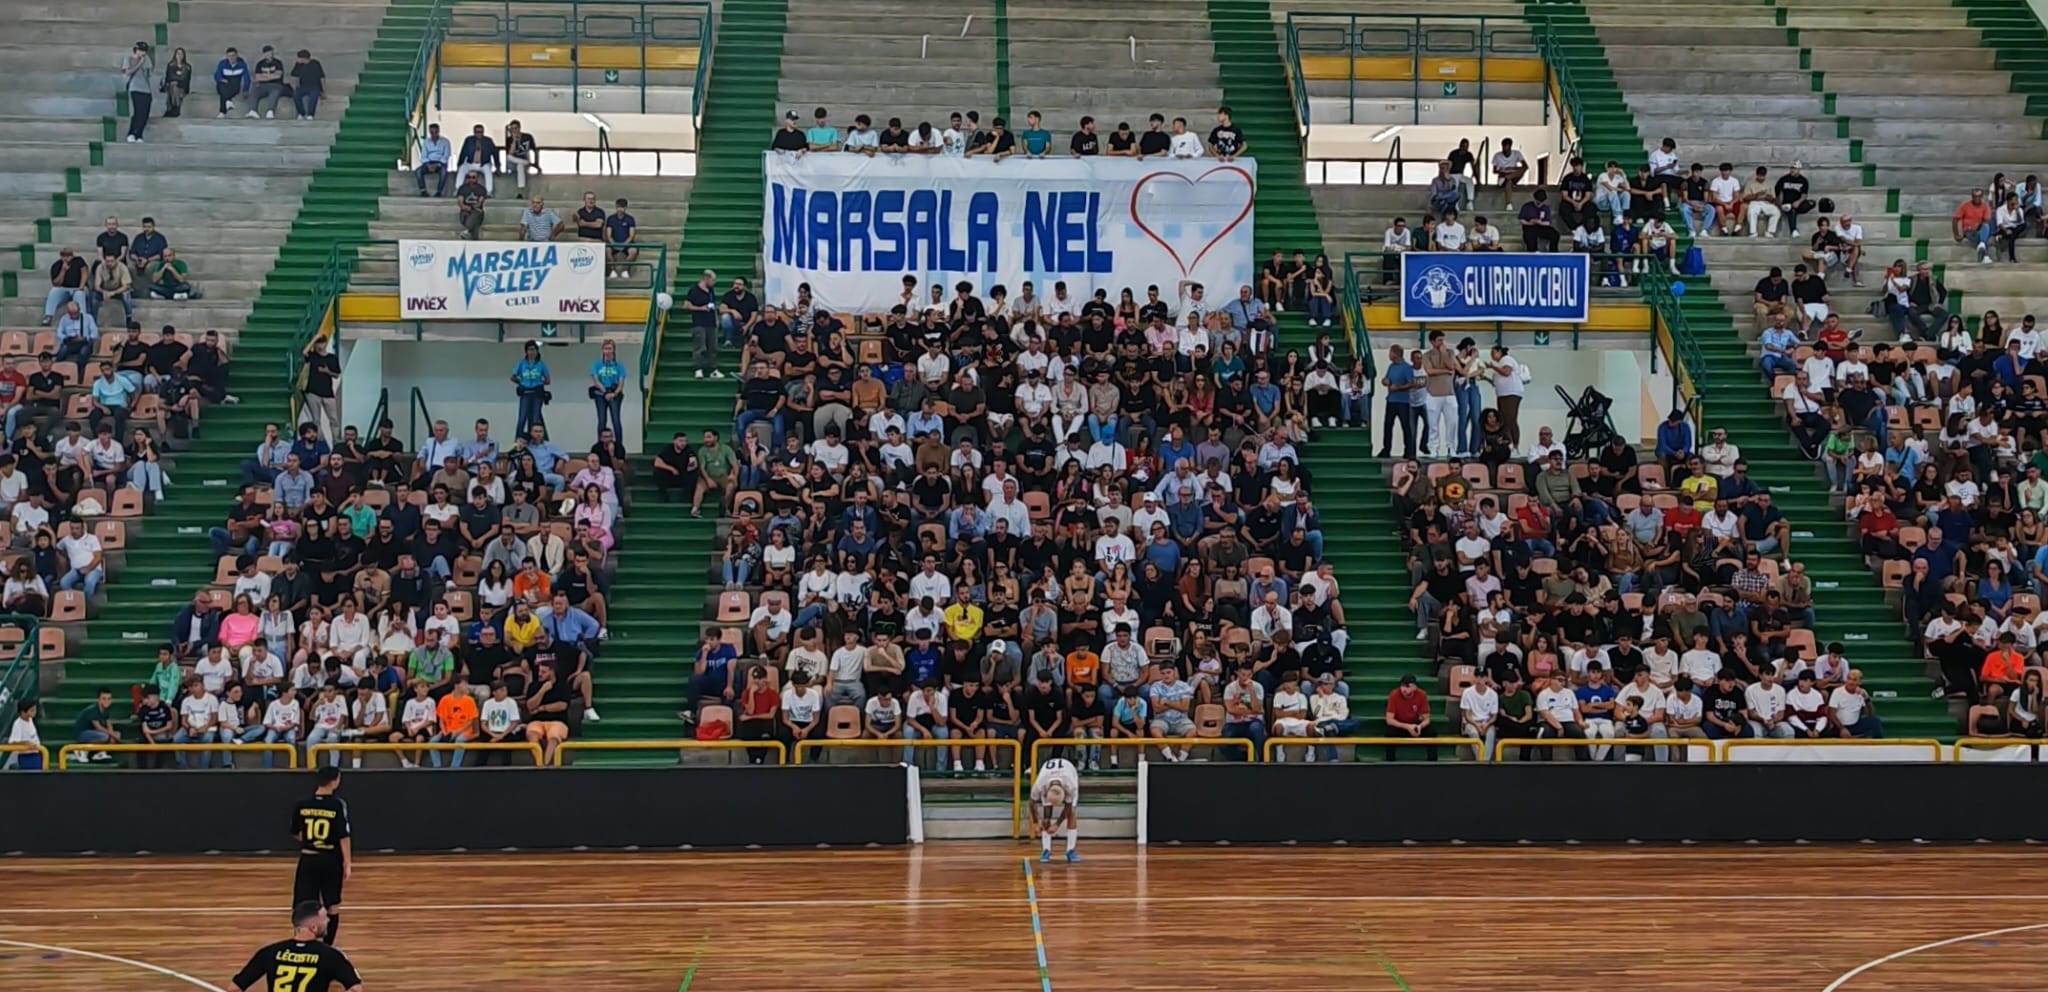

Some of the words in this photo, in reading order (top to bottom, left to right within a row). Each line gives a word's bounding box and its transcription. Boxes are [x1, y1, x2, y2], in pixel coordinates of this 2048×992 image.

[772, 182, 998, 272] MARSALA
[1023, 191, 1113, 273] NEL
[447, 245, 558, 280] MARSALA
[1464, 266, 1486, 306] GLI
[1488, 266, 1578, 307] IRRIDUCIBILI
[407, 295, 447, 311] IMEX
[505, 296, 540, 307] CLUB
[559, 299, 600, 313] IMEX
[304, 818, 330, 840] 10
[273, 965, 317, 992] 27
